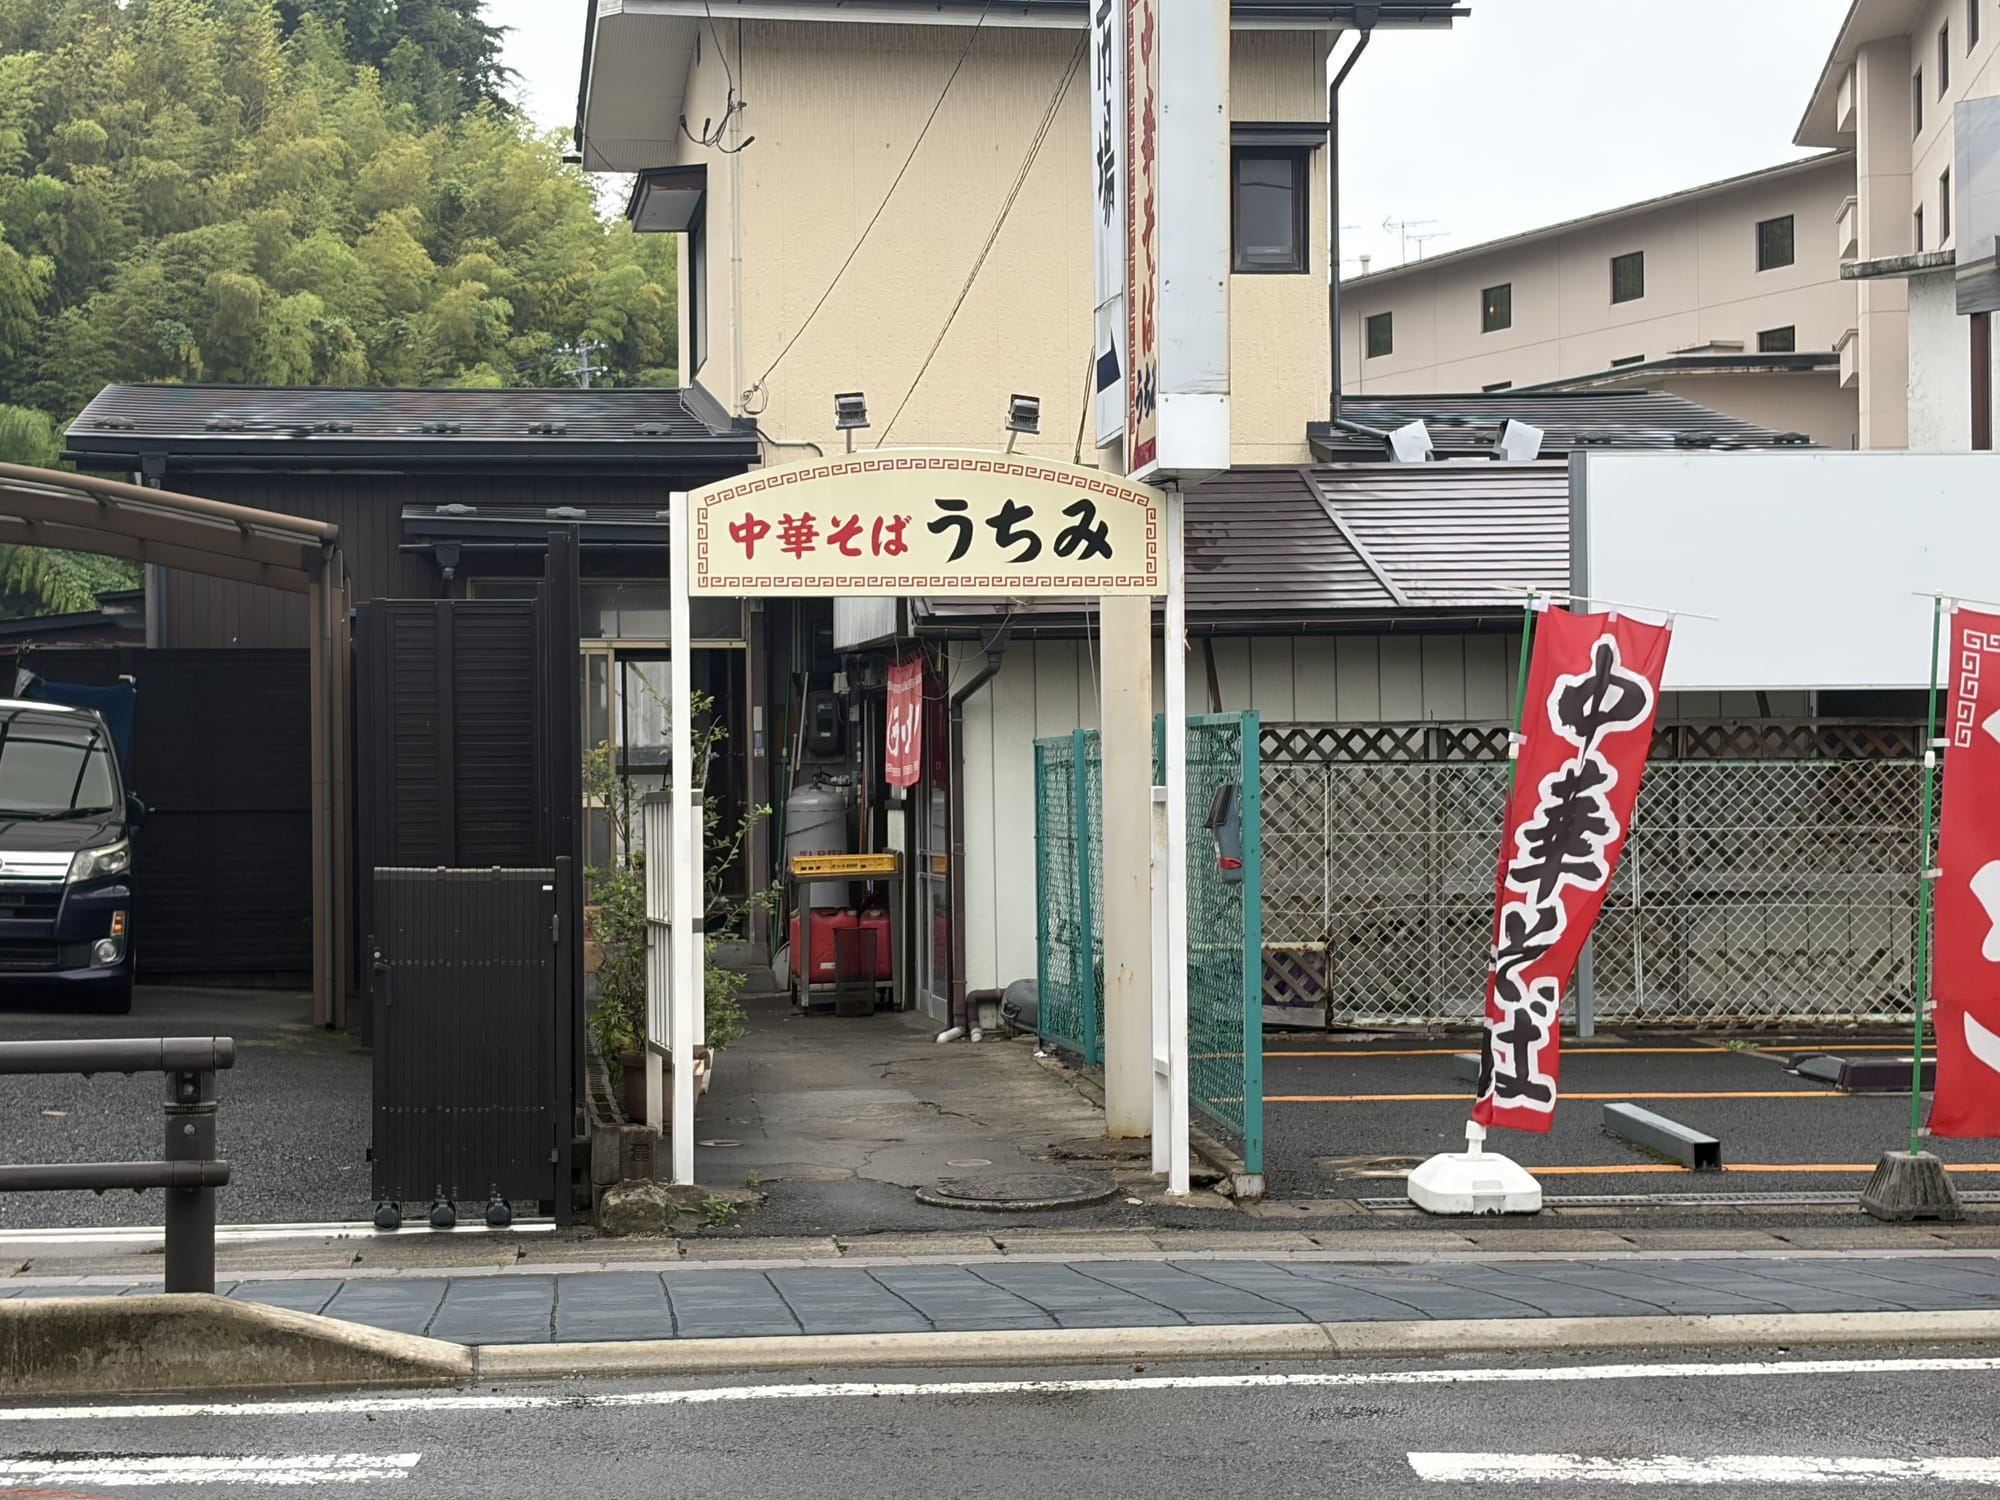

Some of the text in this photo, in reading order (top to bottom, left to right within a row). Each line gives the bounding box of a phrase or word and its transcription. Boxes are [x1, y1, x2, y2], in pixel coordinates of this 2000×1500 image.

[1140, 0, 1155, 357] 中華そば
[729, 498, 1113, 564] 中華そば うちみ
[1478, 635, 1653, 1110] 中華そば
